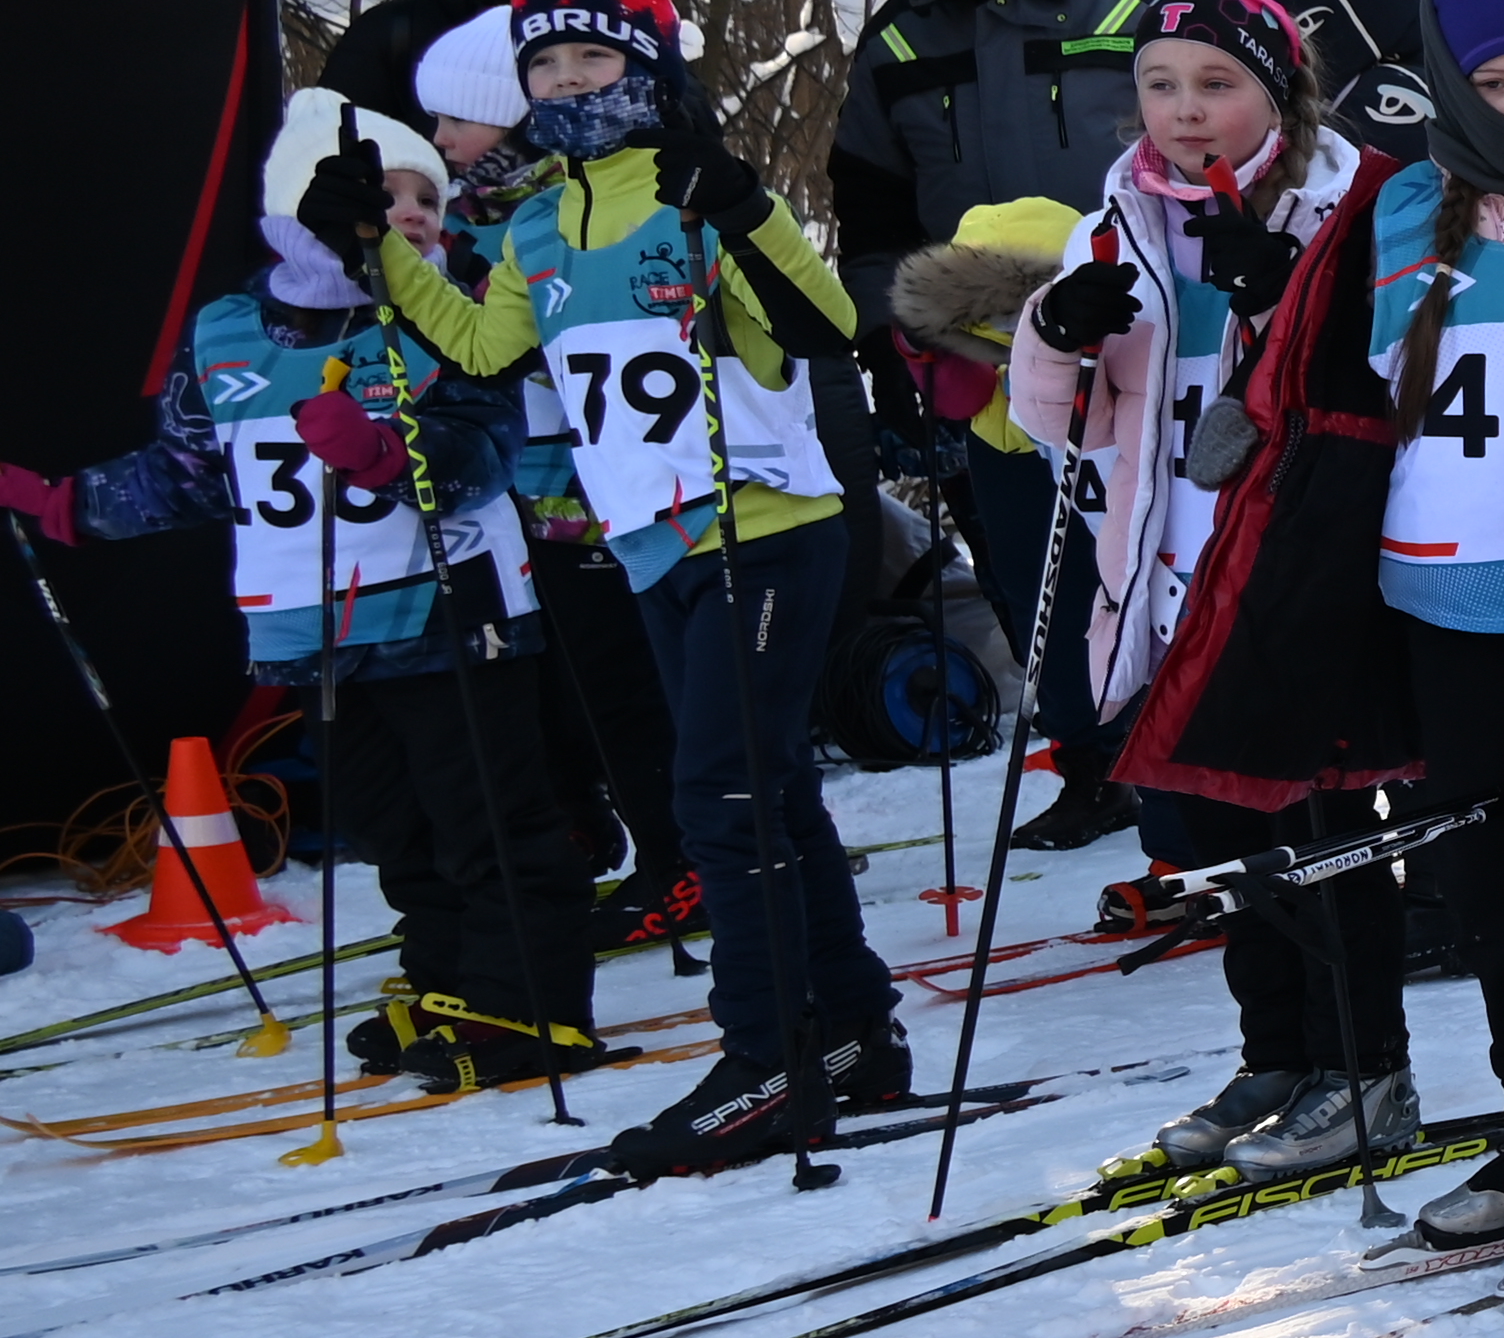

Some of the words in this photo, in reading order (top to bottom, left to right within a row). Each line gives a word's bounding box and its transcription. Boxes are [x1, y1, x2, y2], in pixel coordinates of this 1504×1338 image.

[628, 272, 670, 291] RACE
[650, 286, 686, 300] TIME
[367, 386, 394, 399] TIM
[567, 351, 701, 446] 79
[1025, 444, 1082, 688] MADSHUS
[756, 587, 776, 653] NORDSKI
[691, 1071, 788, 1136] SPINE
[1287, 1078, 1377, 1142] alpin
[289, 1182, 444, 1224] KARHU
[207, 1247, 366, 1295] KARHU
